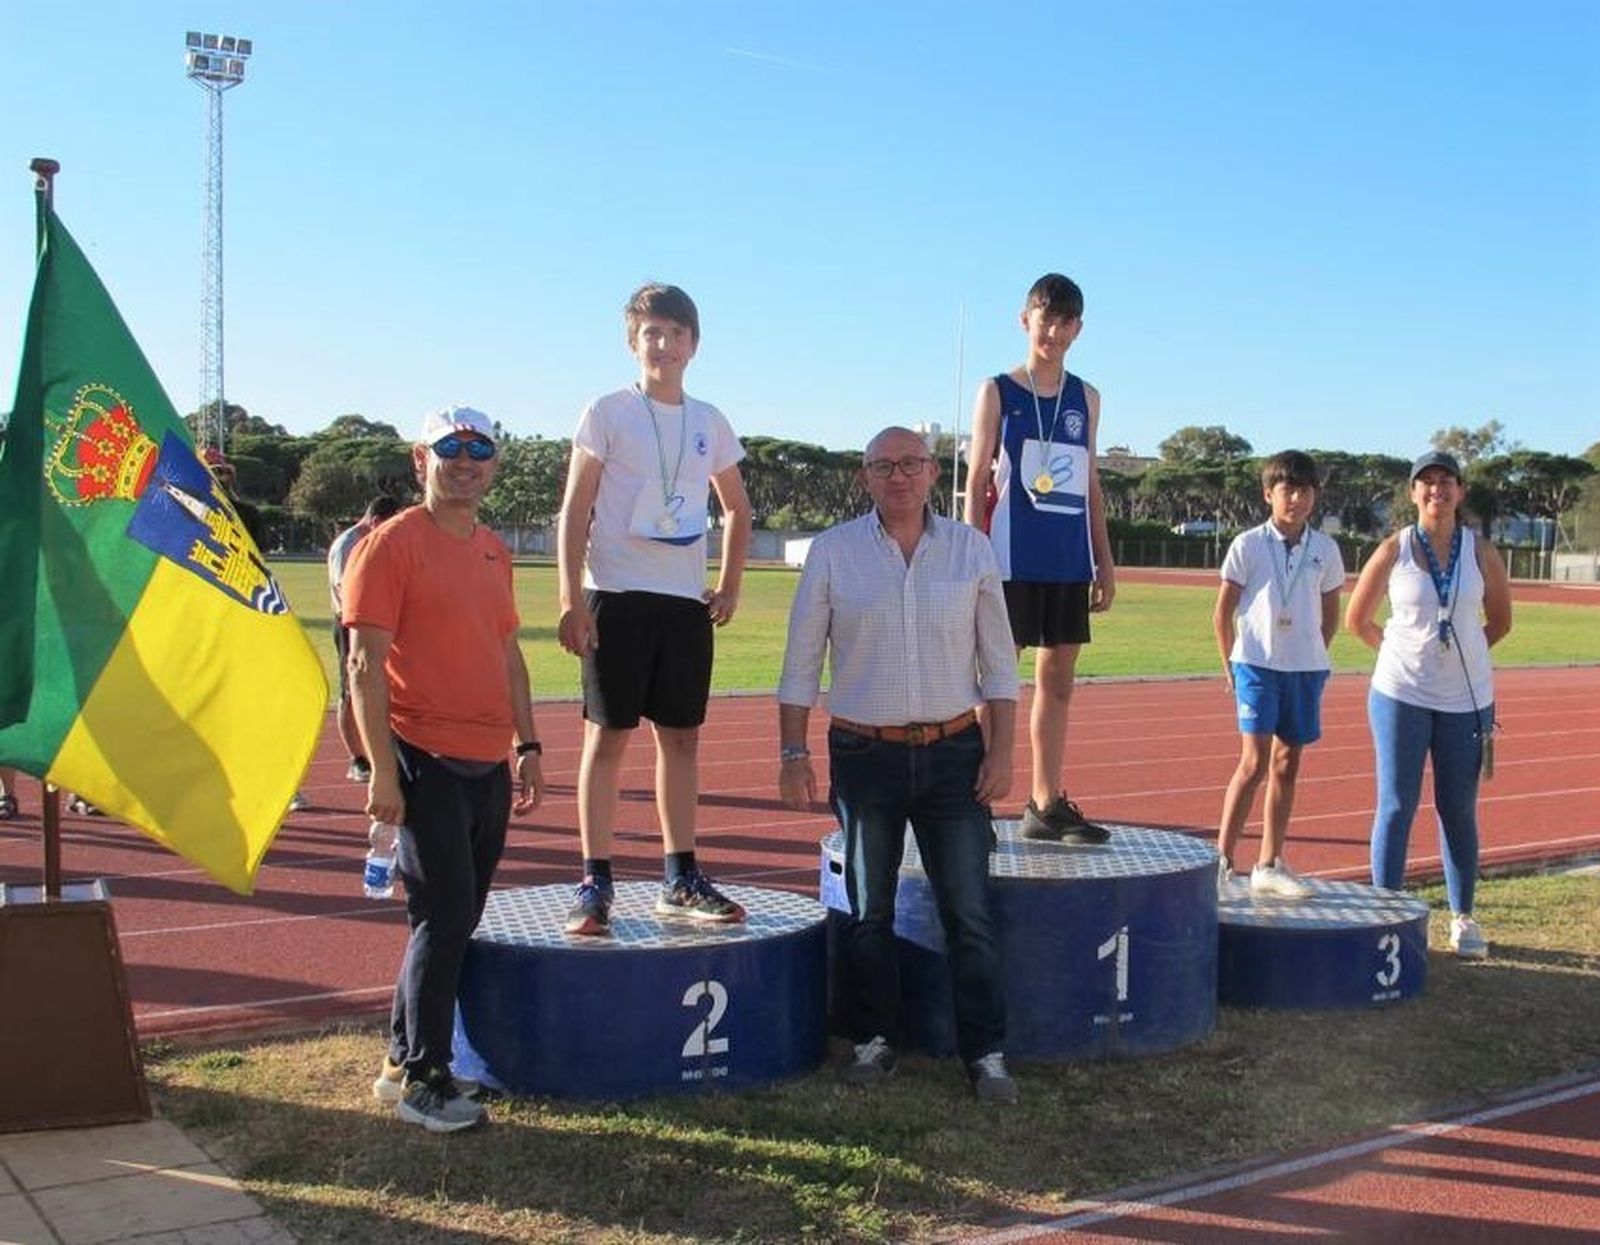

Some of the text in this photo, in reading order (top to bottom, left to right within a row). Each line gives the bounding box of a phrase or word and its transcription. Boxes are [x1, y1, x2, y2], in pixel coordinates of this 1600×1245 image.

[1097, 925, 1129, 1001] 1
[1376, 933, 1401, 987] 3
[682, 980, 728, 1057] 2
